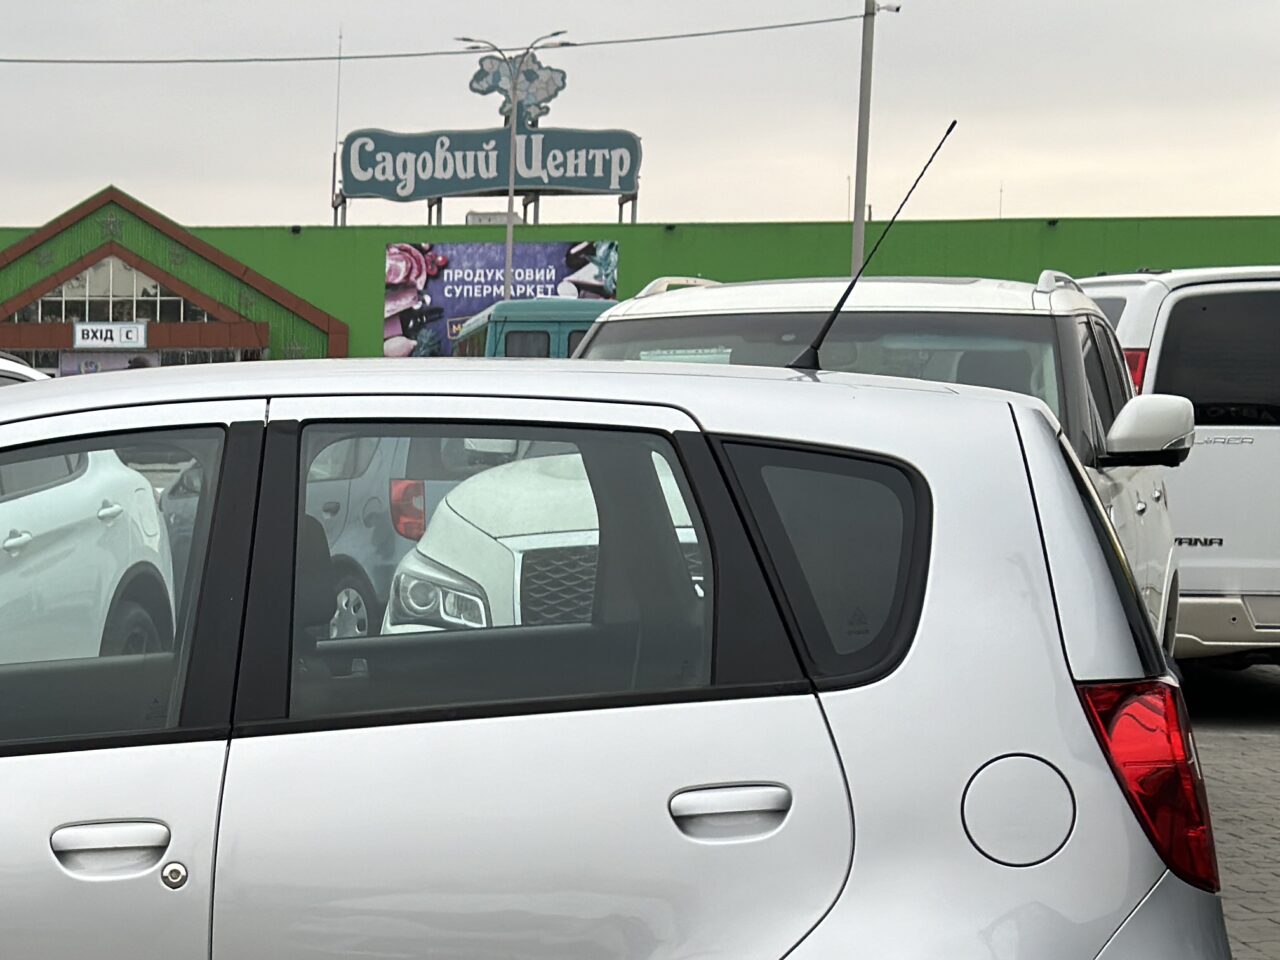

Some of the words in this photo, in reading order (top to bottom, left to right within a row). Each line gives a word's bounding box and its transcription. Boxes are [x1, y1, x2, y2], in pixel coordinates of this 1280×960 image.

[350, 136, 498, 197] Садовий
[515, 134, 631, 189] Центр
[443, 265, 556, 282] ПРОДУКОВИЙ
[81, 328, 114, 342] ВХІД
